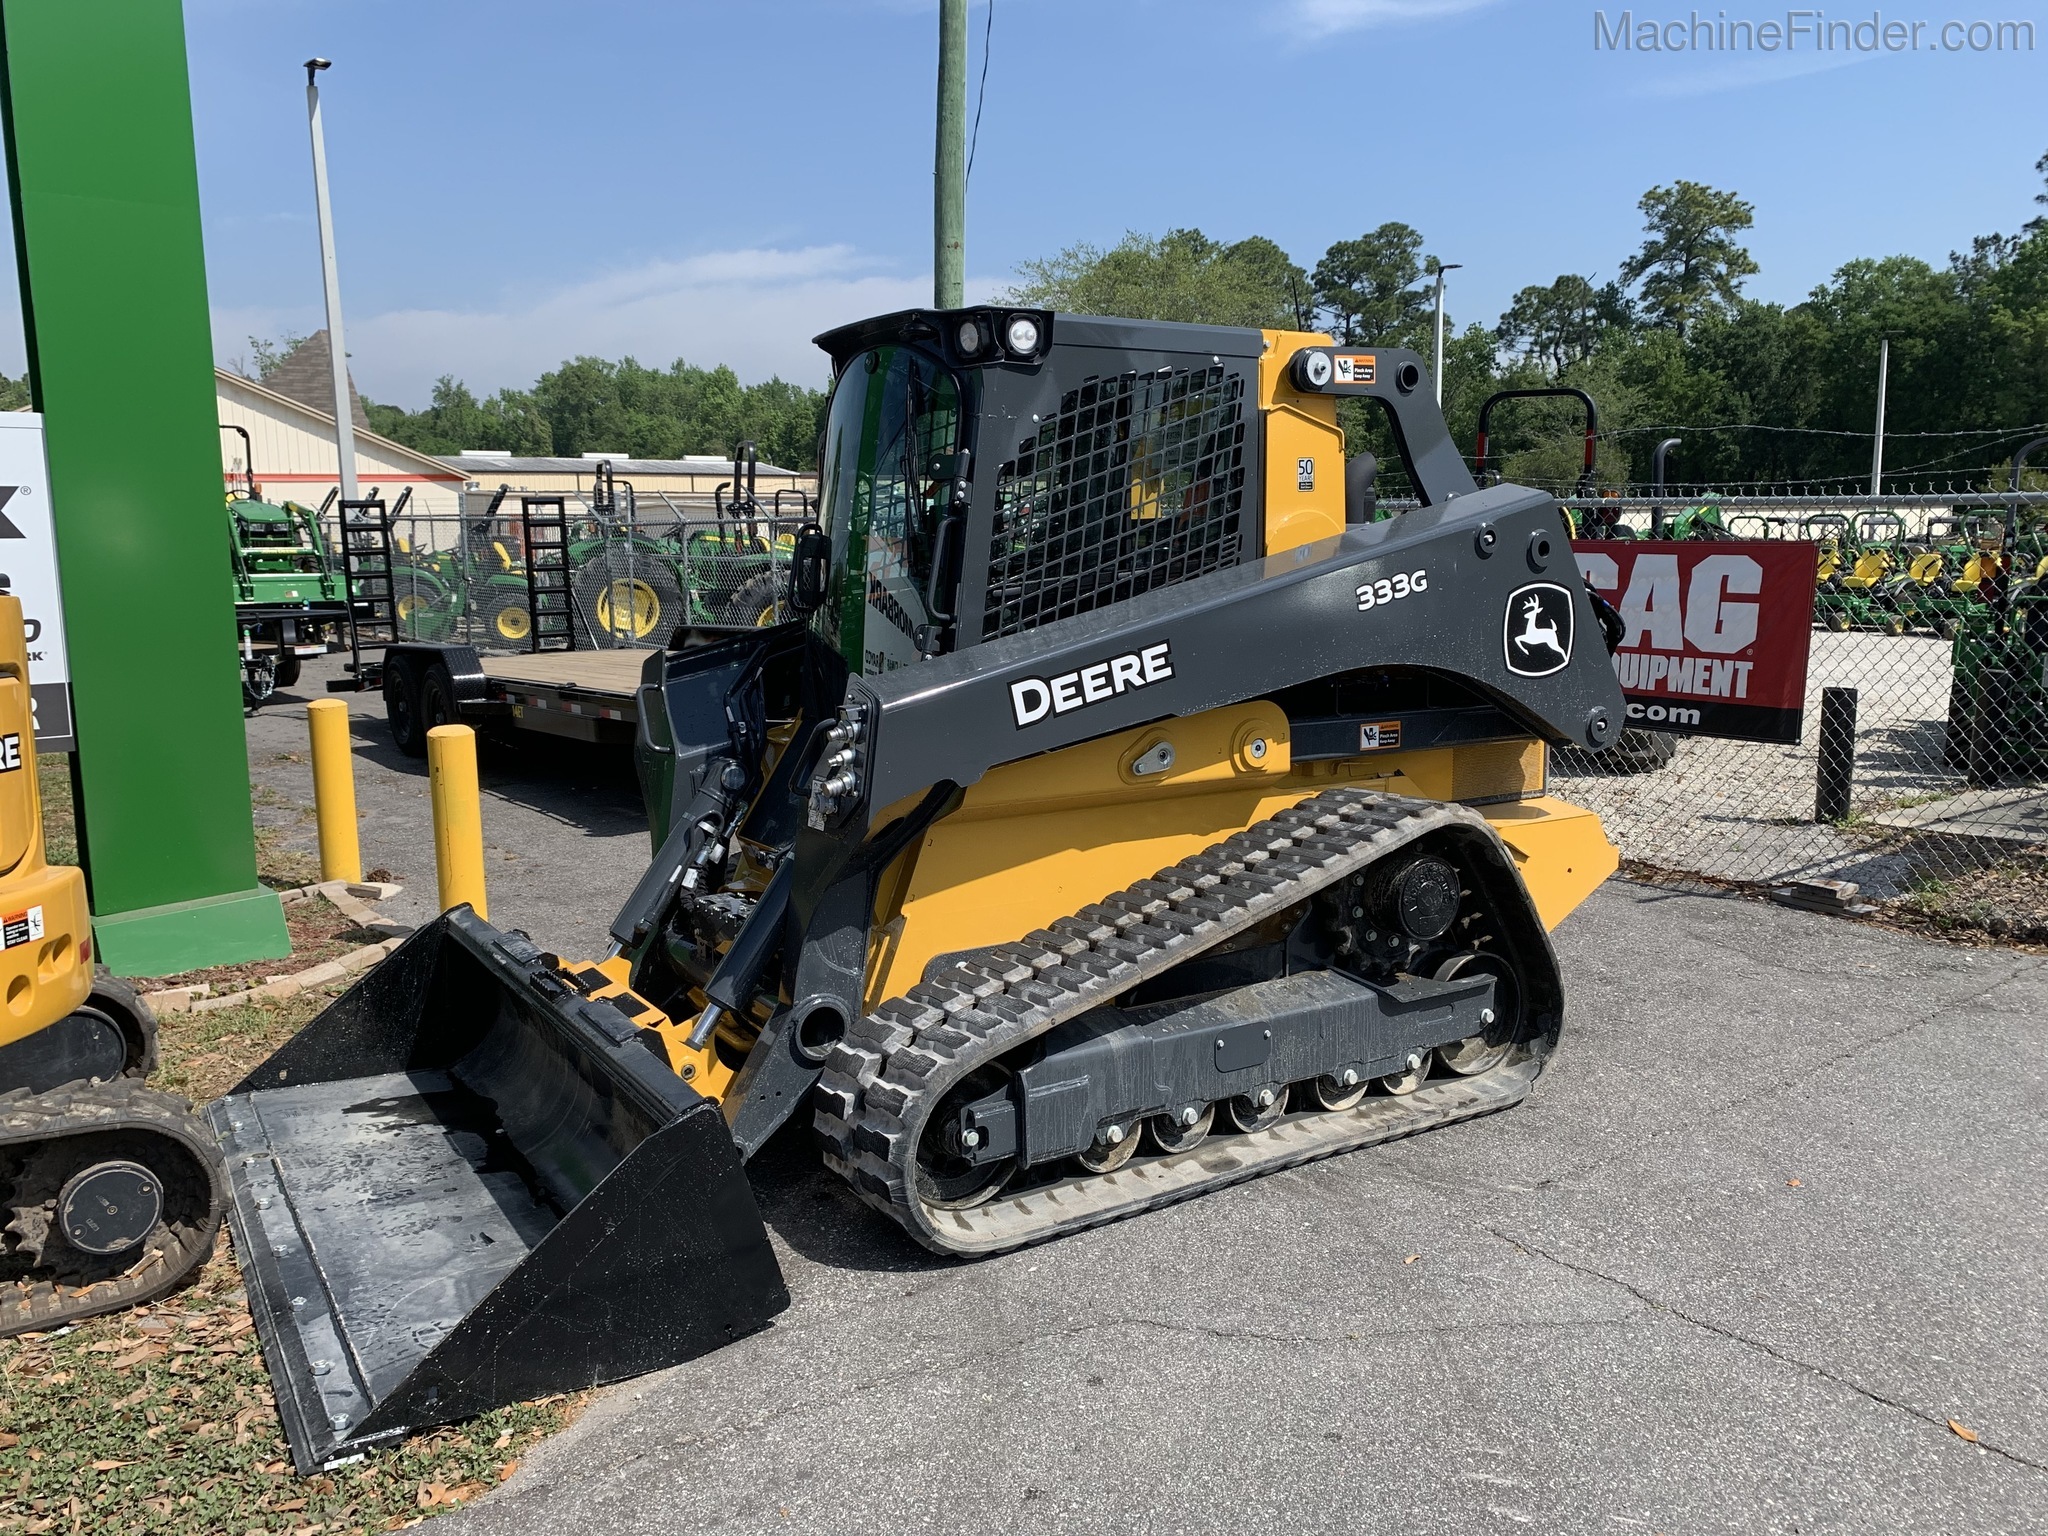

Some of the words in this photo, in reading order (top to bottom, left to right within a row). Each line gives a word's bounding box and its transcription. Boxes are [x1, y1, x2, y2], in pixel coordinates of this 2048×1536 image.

[1298, 459, 1313, 475] 50
[1355, 569, 1428, 611] 333G
[1010, 642, 1173, 726] DEERE
